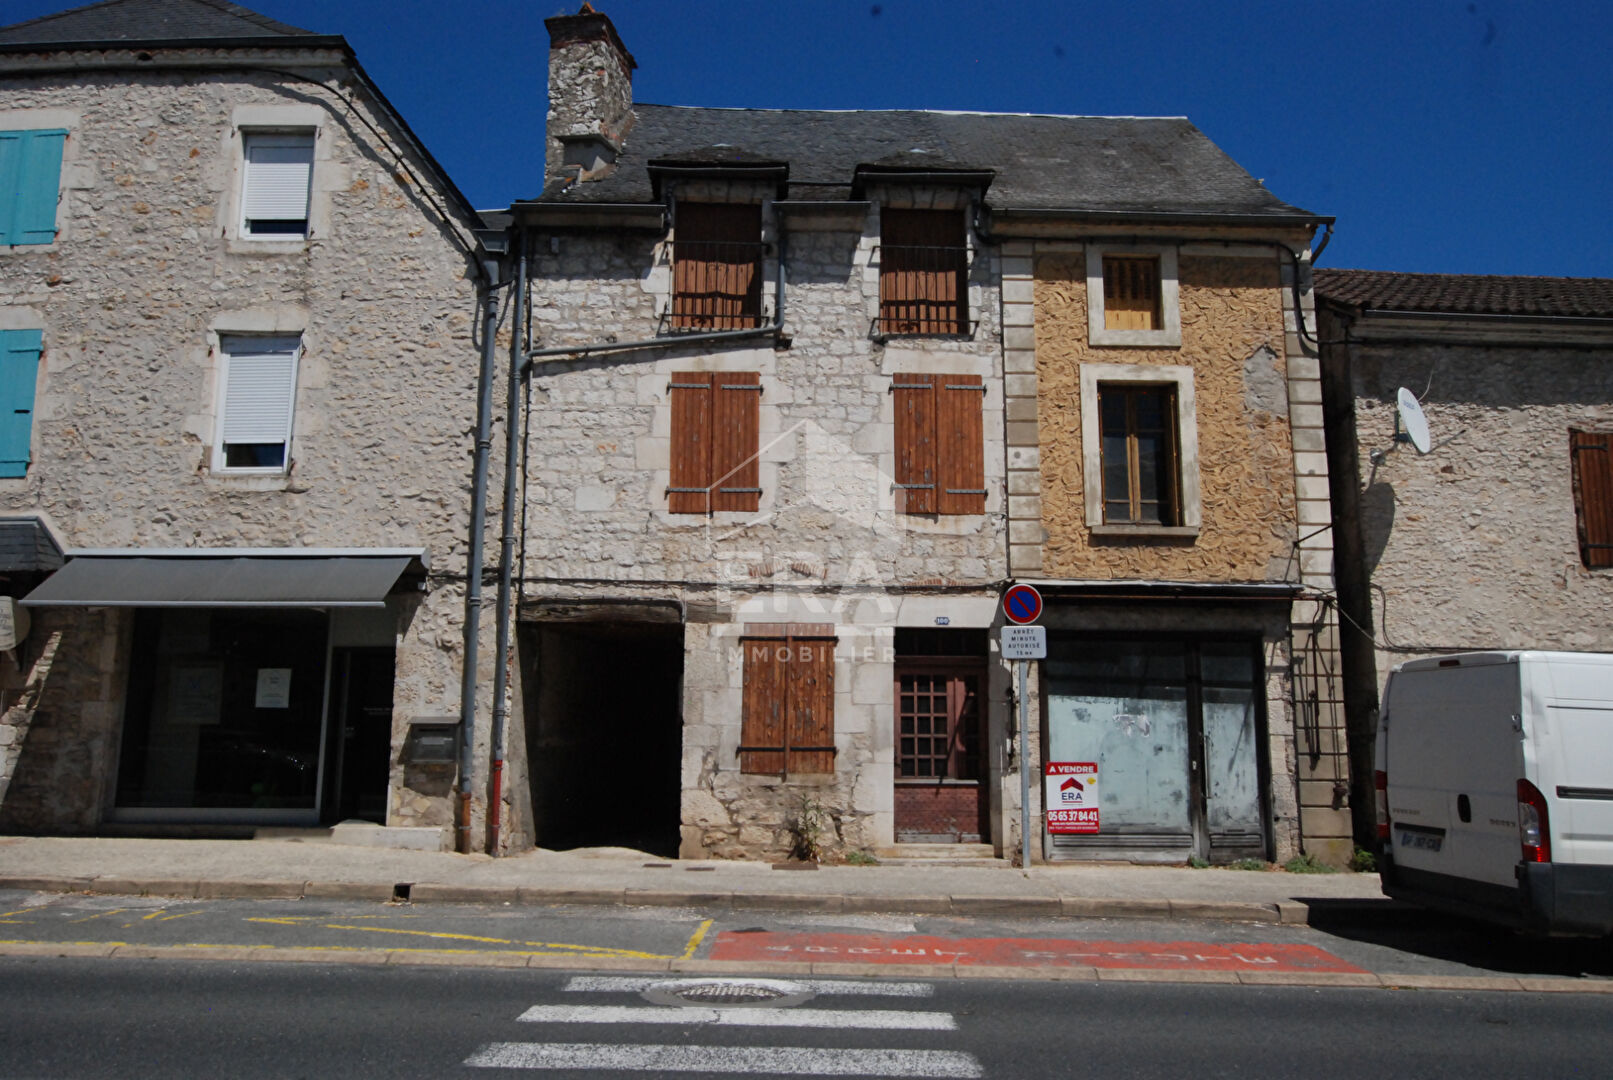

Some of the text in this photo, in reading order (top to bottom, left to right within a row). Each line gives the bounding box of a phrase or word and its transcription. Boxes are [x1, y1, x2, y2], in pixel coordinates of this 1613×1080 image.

[1058, 765, 1094, 773] VENDRE
[1061, 792, 1083, 801] ERA
[1048, 811, 1098, 821] 05 65 37 84 41
